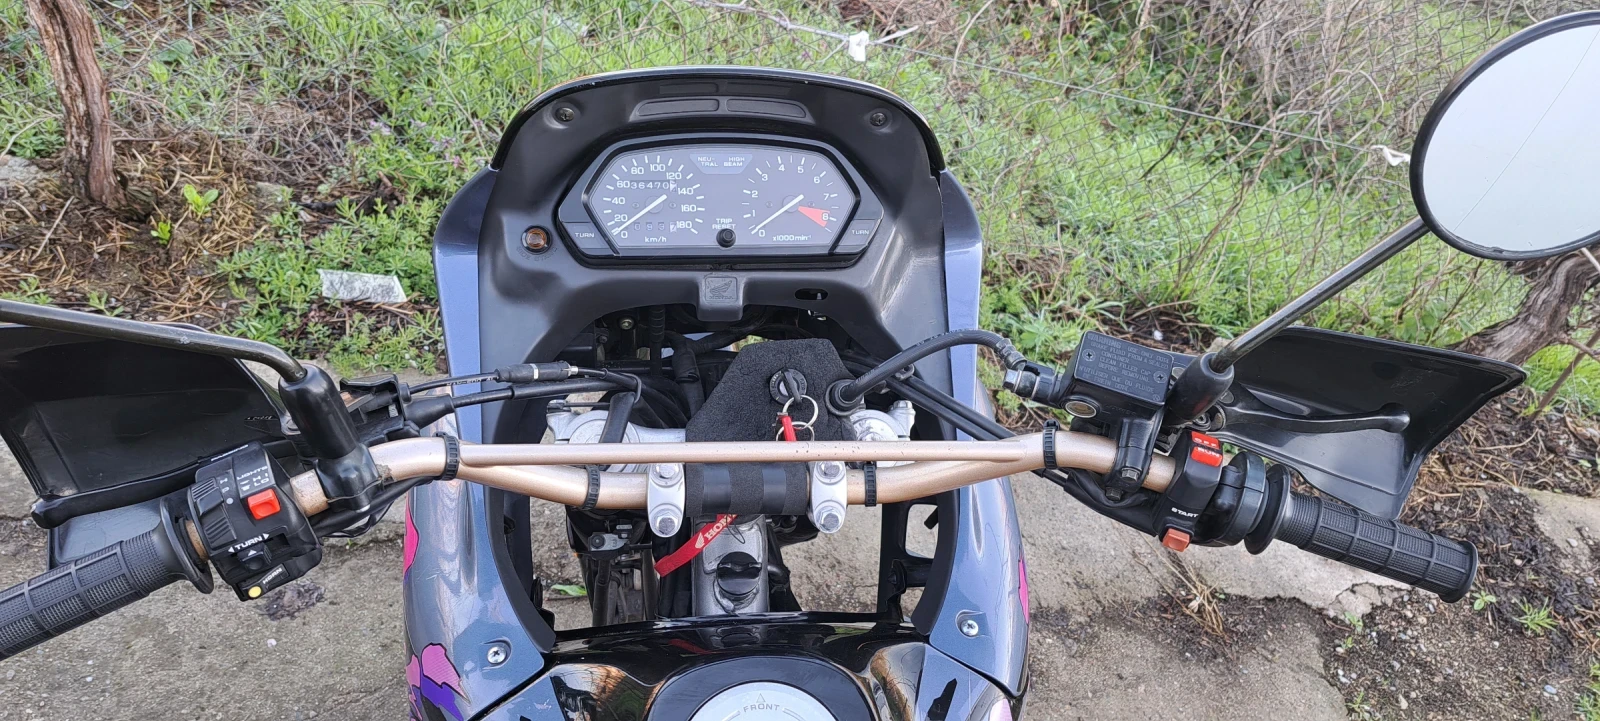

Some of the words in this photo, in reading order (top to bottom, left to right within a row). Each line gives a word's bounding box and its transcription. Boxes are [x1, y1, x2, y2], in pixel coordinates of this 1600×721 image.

[631, 167, 644, 175] 80
[650, 164, 666, 172] 100
[666, 172, 682, 180] 120
[677, 187, 694, 195] 140
[751, 190, 758, 198] 2
[611, 197, 626, 205] 40
[681, 204, 697, 212] 160
[752, 209, 756, 217] 1
[614, 214, 628, 222] 20
[676, 220, 692, 229] 180
[621, 231, 628, 239] 0
[1171, 507, 1199, 518] START
[234, 535, 263, 551] TURN
[262, 568, 283, 584] HORN
[743, 703, 780, 713] FRONT
